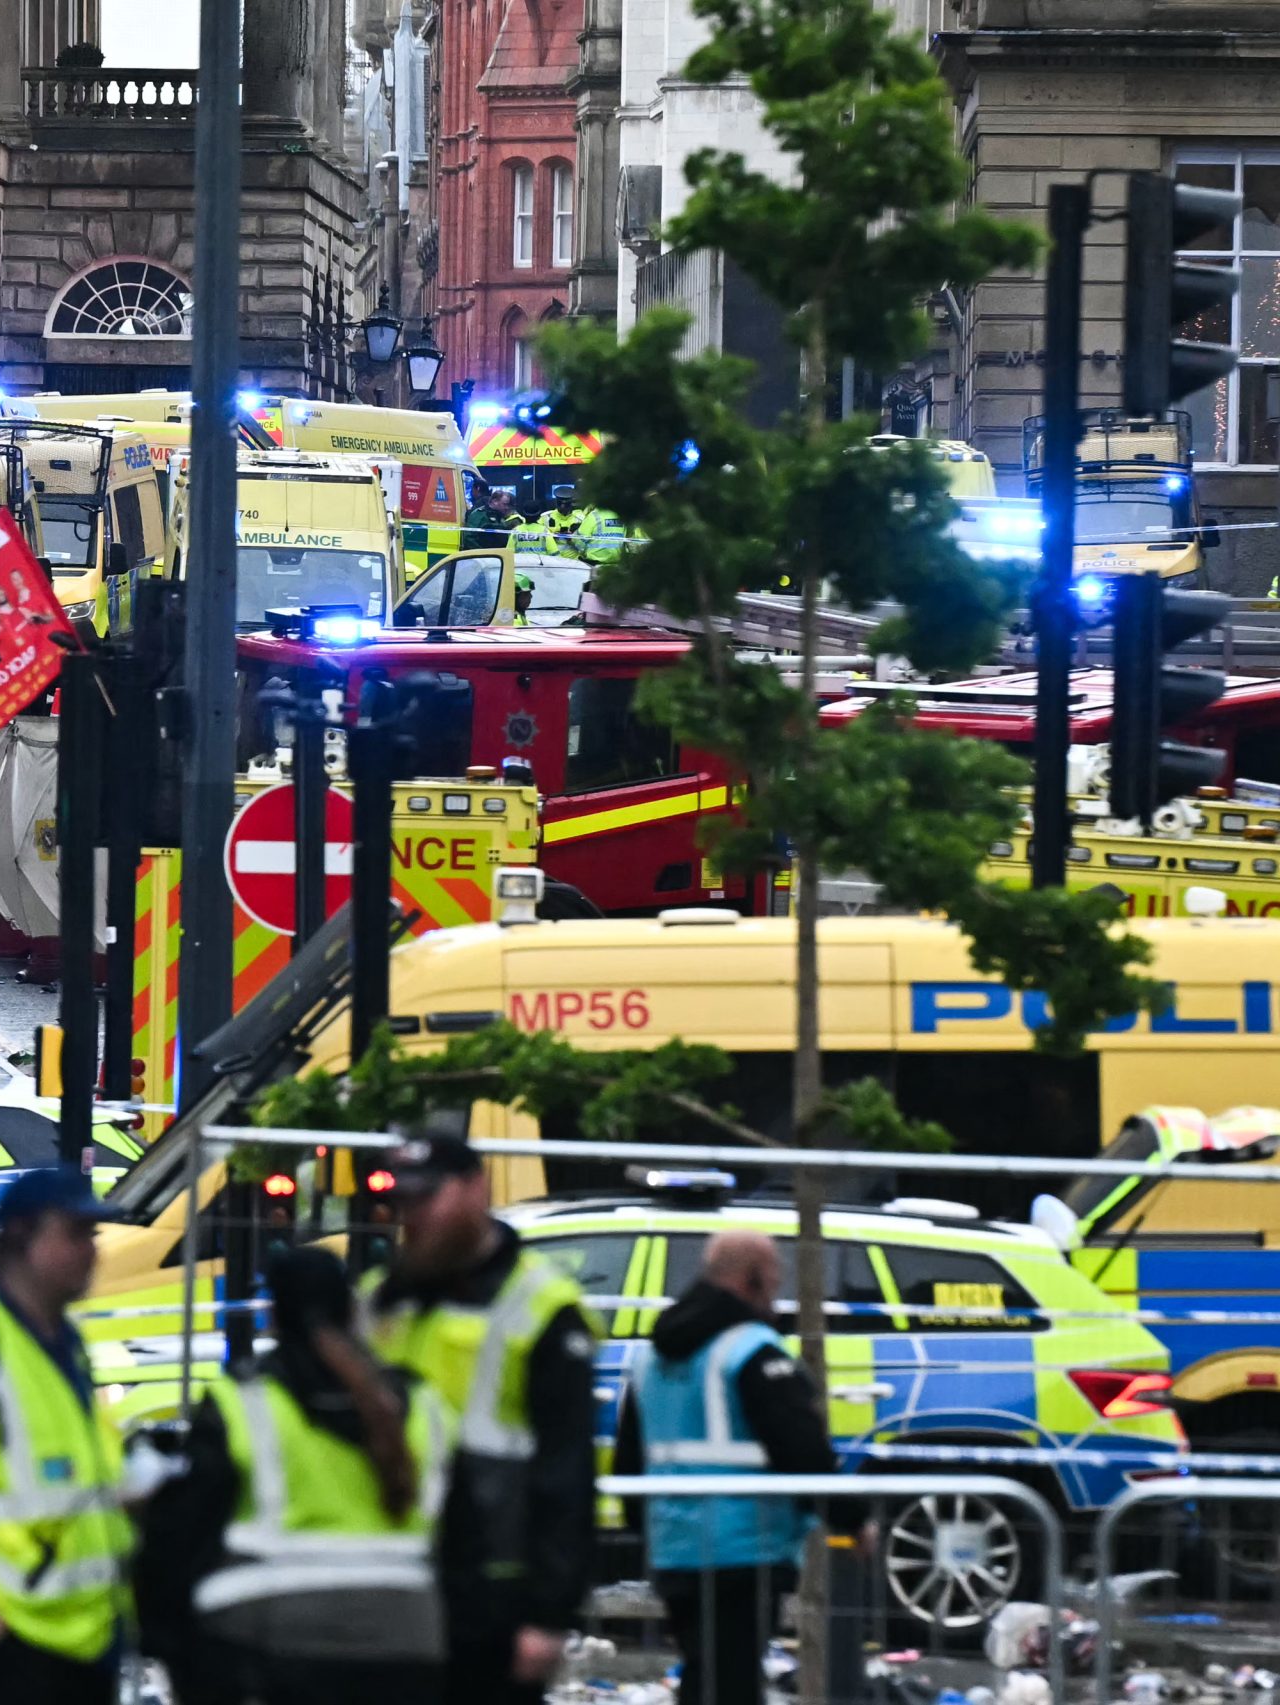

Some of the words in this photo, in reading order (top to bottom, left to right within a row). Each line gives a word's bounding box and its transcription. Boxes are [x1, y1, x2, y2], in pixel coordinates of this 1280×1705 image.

[331, 436, 382, 453] EMERGENCY
[383, 440, 435, 456] AMBULANCE
[493, 446, 582, 459] AMBULANCE
[235, 532, 342, 547] AMBULANCE
[1082, 559, 1137, 567] POLICE
[511, 990, 650, 1031] MP56
